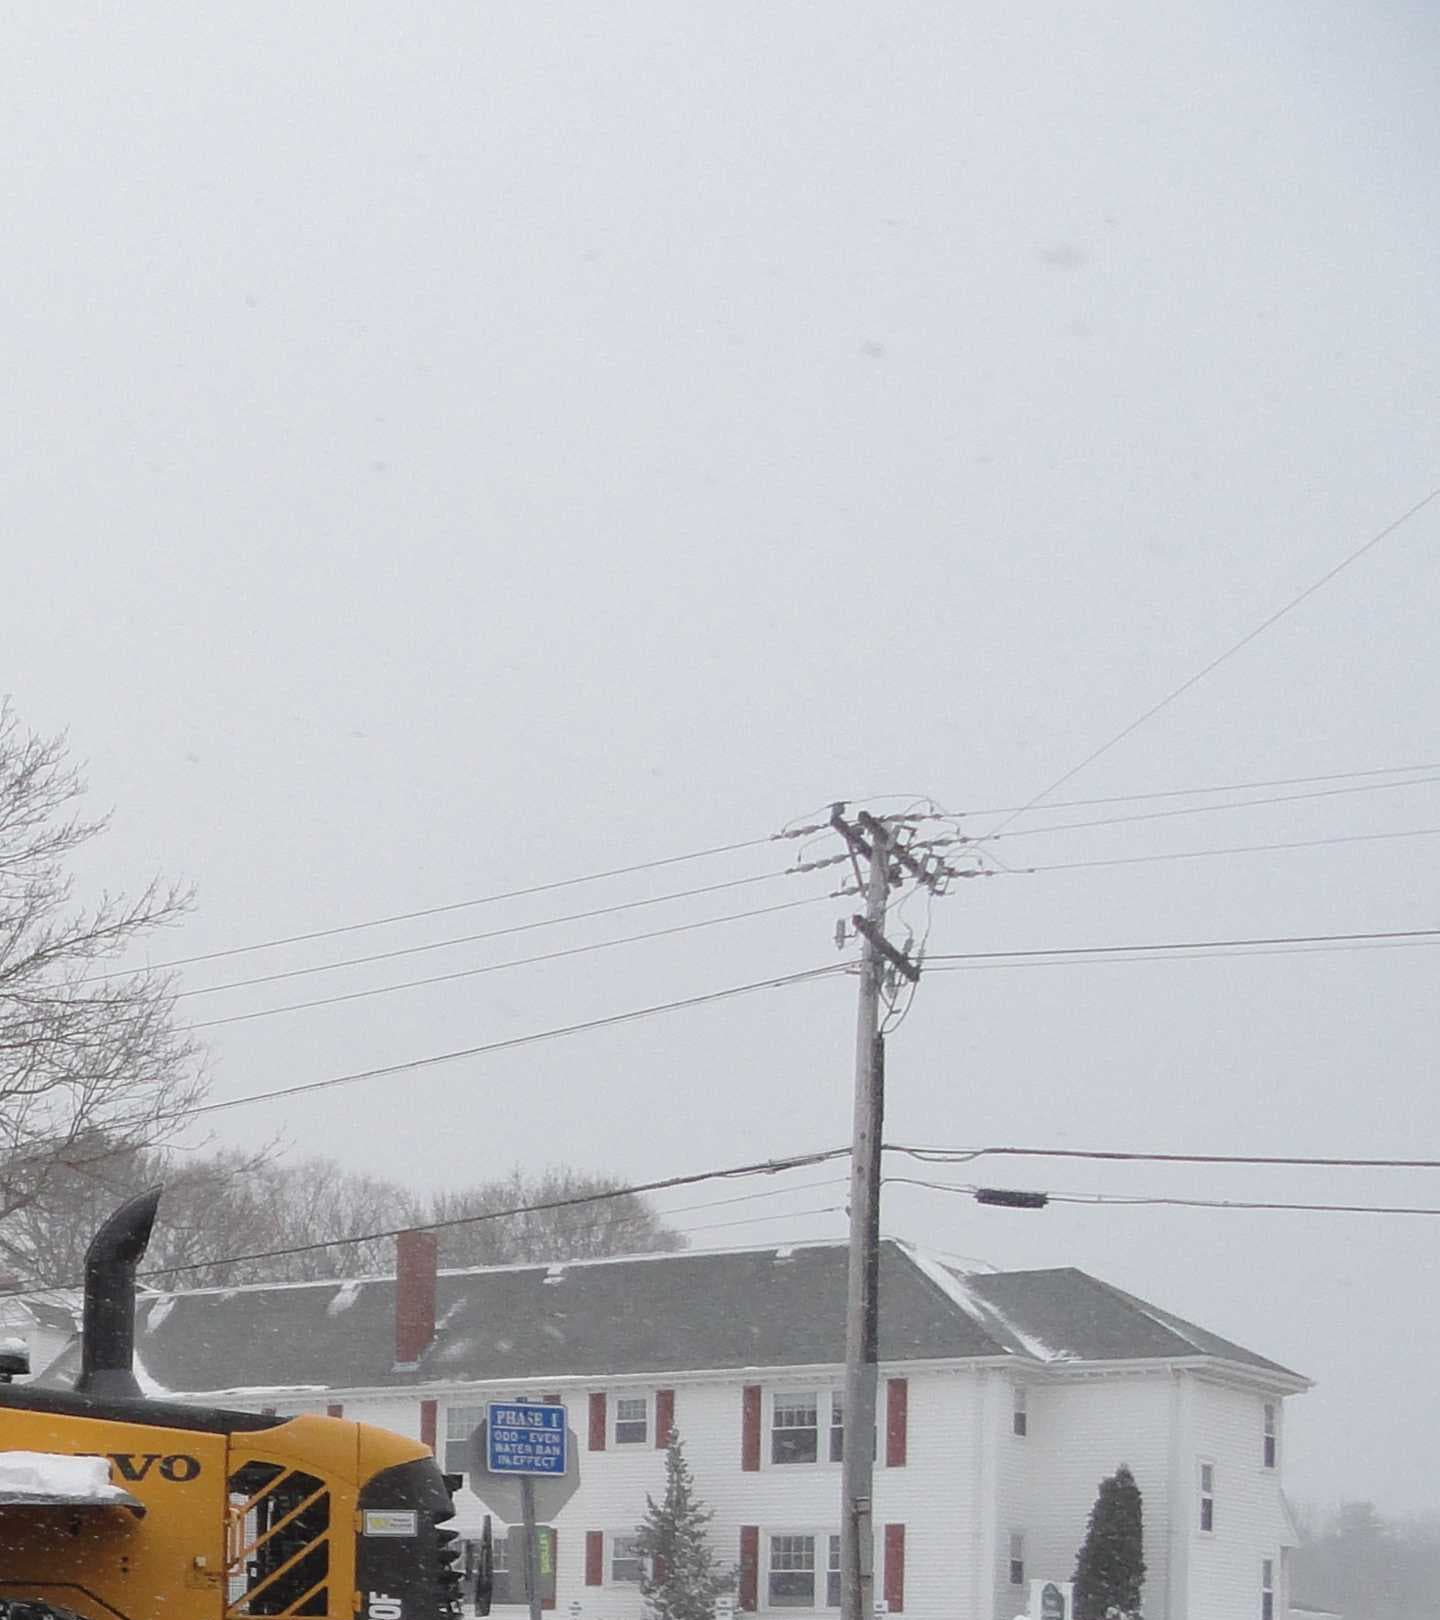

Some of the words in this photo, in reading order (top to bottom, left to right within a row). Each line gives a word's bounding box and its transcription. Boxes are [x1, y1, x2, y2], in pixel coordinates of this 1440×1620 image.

[496, 1411, 544, 1426] PHASE
[552, 1413, 559, 1427] I
[529, 1433, 560, 1443] EVEN
[496, 1443, 532, 1454] WATER
[536, 1445, 560, 1455] BAN
[498, 1455, 511, 1465] IN
[513, 1455, 556, 1467] EFFECT
